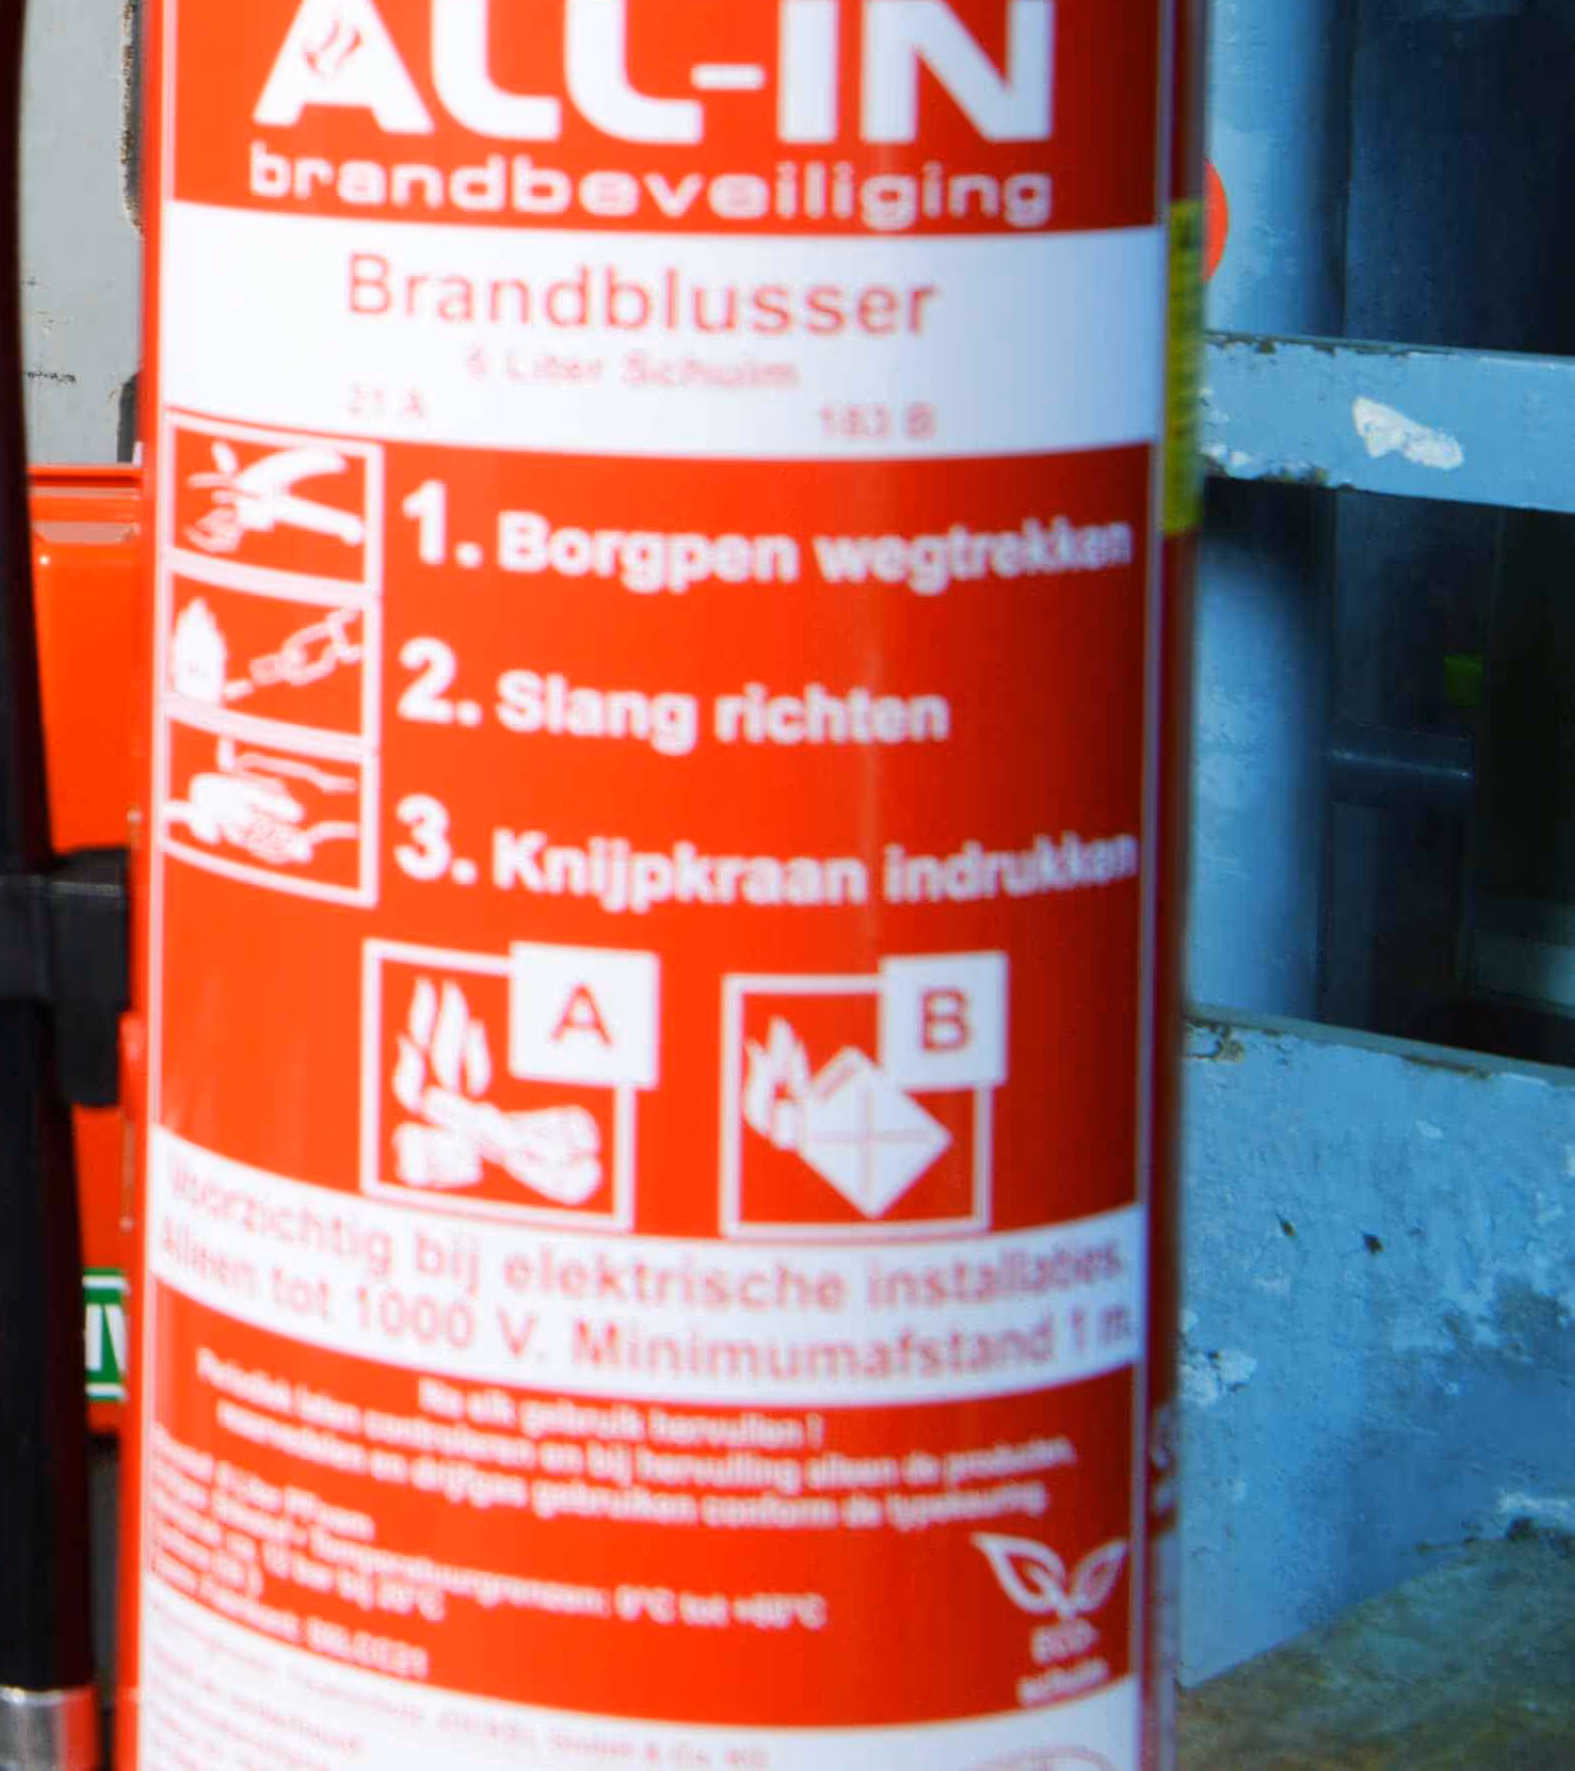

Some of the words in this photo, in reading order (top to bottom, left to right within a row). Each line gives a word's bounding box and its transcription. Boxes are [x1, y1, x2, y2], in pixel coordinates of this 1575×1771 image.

[249, 139, 1052, 230] brandbeveiliging
[348, 251, 941, 337] Brandblusser
[505, 346, 604, 384] Liter
[621, 348, 798, 390] Schuim
[400, 479, 481, 567] 1.
[497, 511, 798, 594] Borgpen
[815, 515, 1132, 595] wegtrekken
[397, 637, 481, 724] 2.
[496, 671, 697, 753] Slang
[715, 681, 948, 744] richten
[395, 795, 477, 884] 3.
[494, 830, 867, 913] Knijpkraan
[884, 832, 1139, 904] indrukken
[550, 982, 615, 1048] A
[923, 987, 970, 1052] B
[414, 1235, 482, 1296] bij
[504, 1244, 846, 1310] elektrische
[271, 1262, 331, 1320] tot
[357, 1285, 475, 1350] 1000
[572, 1312, 1055, 1381] Minimumafstand
